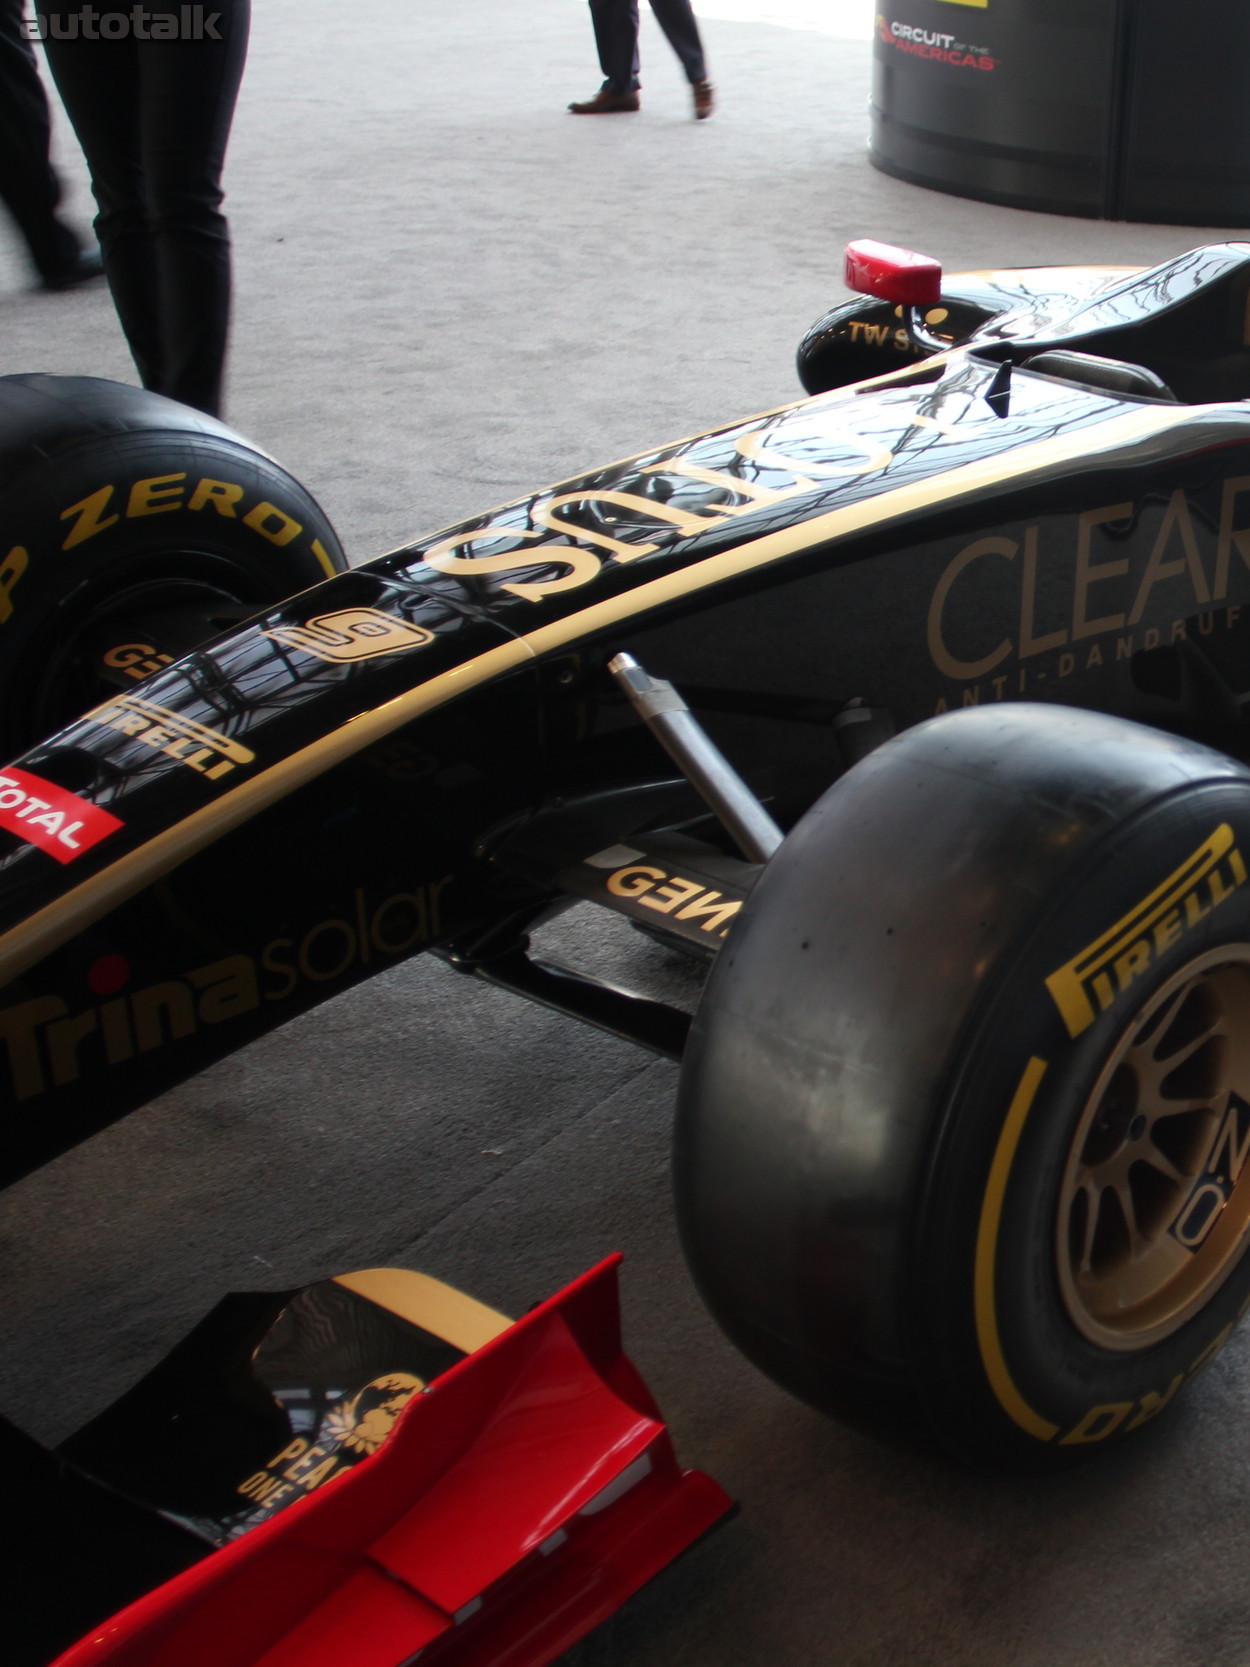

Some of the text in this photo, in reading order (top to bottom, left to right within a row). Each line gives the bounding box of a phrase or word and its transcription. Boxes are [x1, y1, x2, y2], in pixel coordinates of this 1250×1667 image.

[890, 21, 955, 49] CIRCUIT
[969, 45, 990, 56] THE
[895, 39, 995, 71] AMERICAS
[848, 321, 889, 347] TW
[59, 472, 304, 551] ZERO
[80, 694, 257, 781] PIRELLI
[1045, 822, 1247, 1039] PIRELLI
[237, 1471, 295, 1509] ONE
